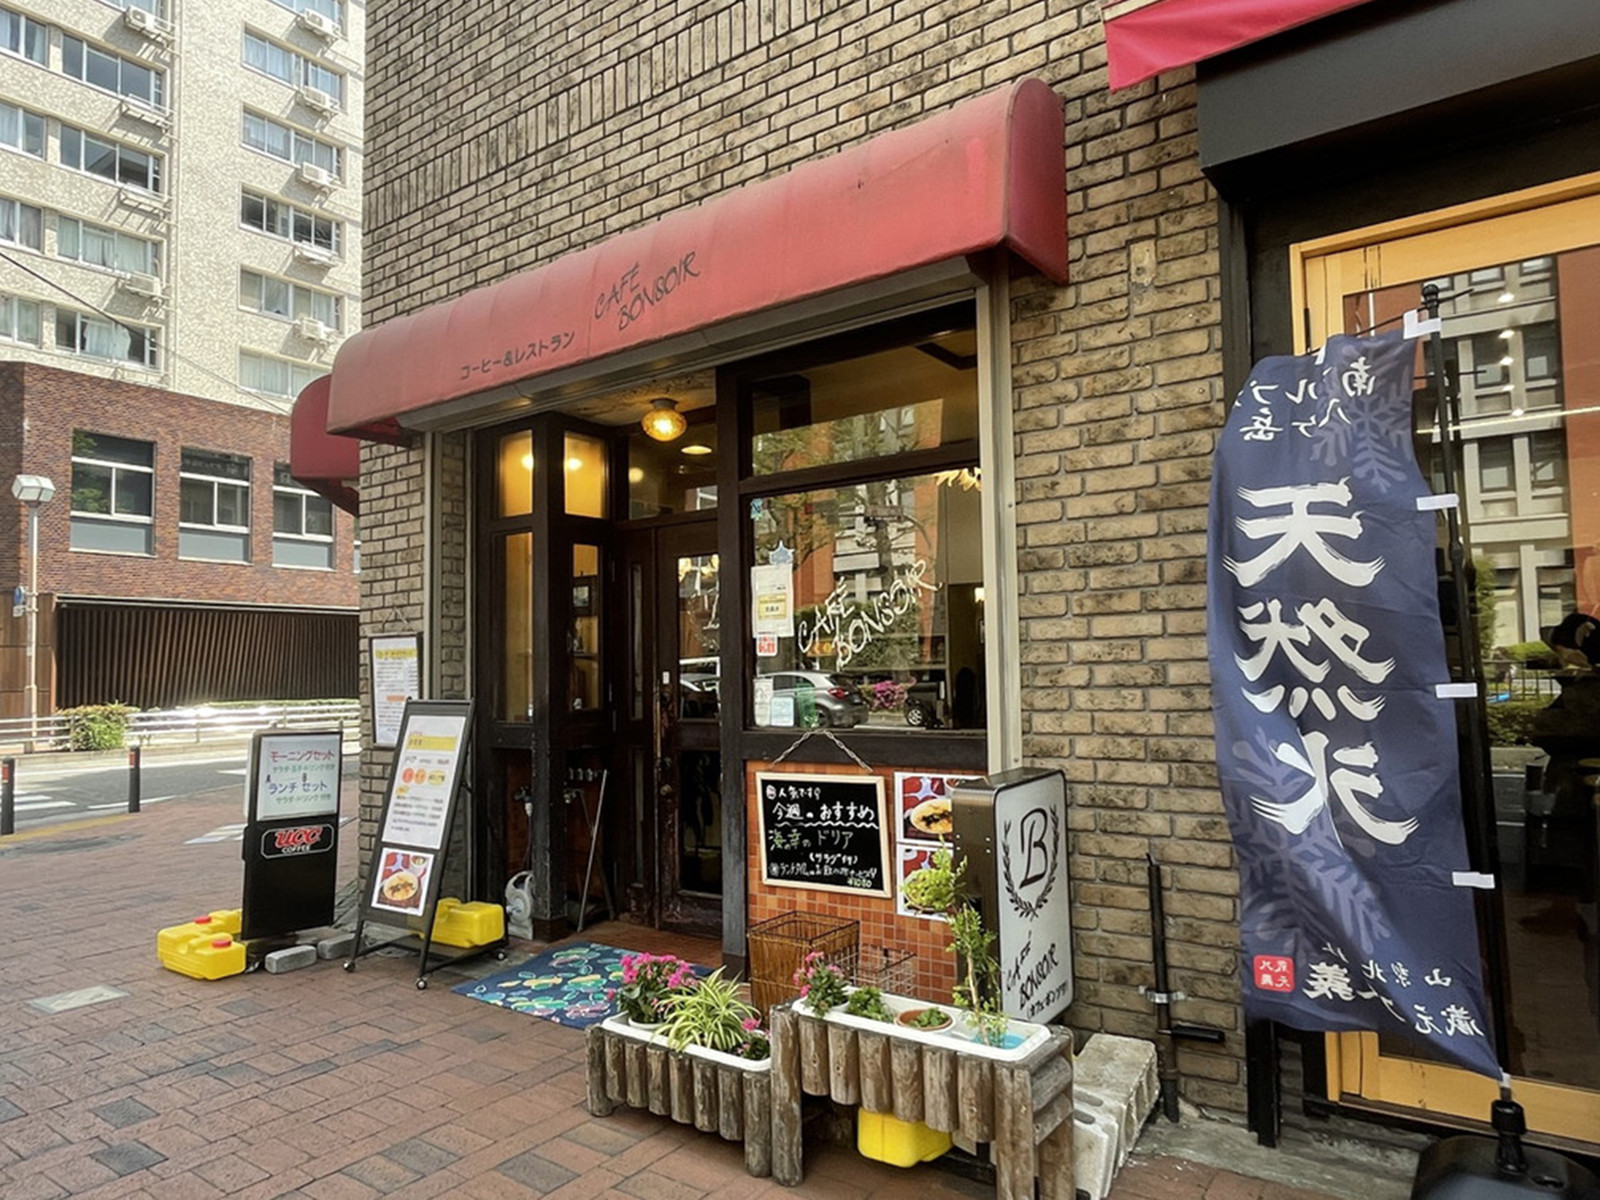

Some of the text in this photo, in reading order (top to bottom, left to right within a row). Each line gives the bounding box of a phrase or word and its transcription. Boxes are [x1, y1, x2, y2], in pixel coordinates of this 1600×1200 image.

[618, 251, 701, 331] BONSOIR
[460, 331, 575, 380] コーヒー&レストラン
[269, 750, 334, 763] モーニングセット
[275, 826, 323, 849] UCC
[281, 843, 311, 854] COFFEE
